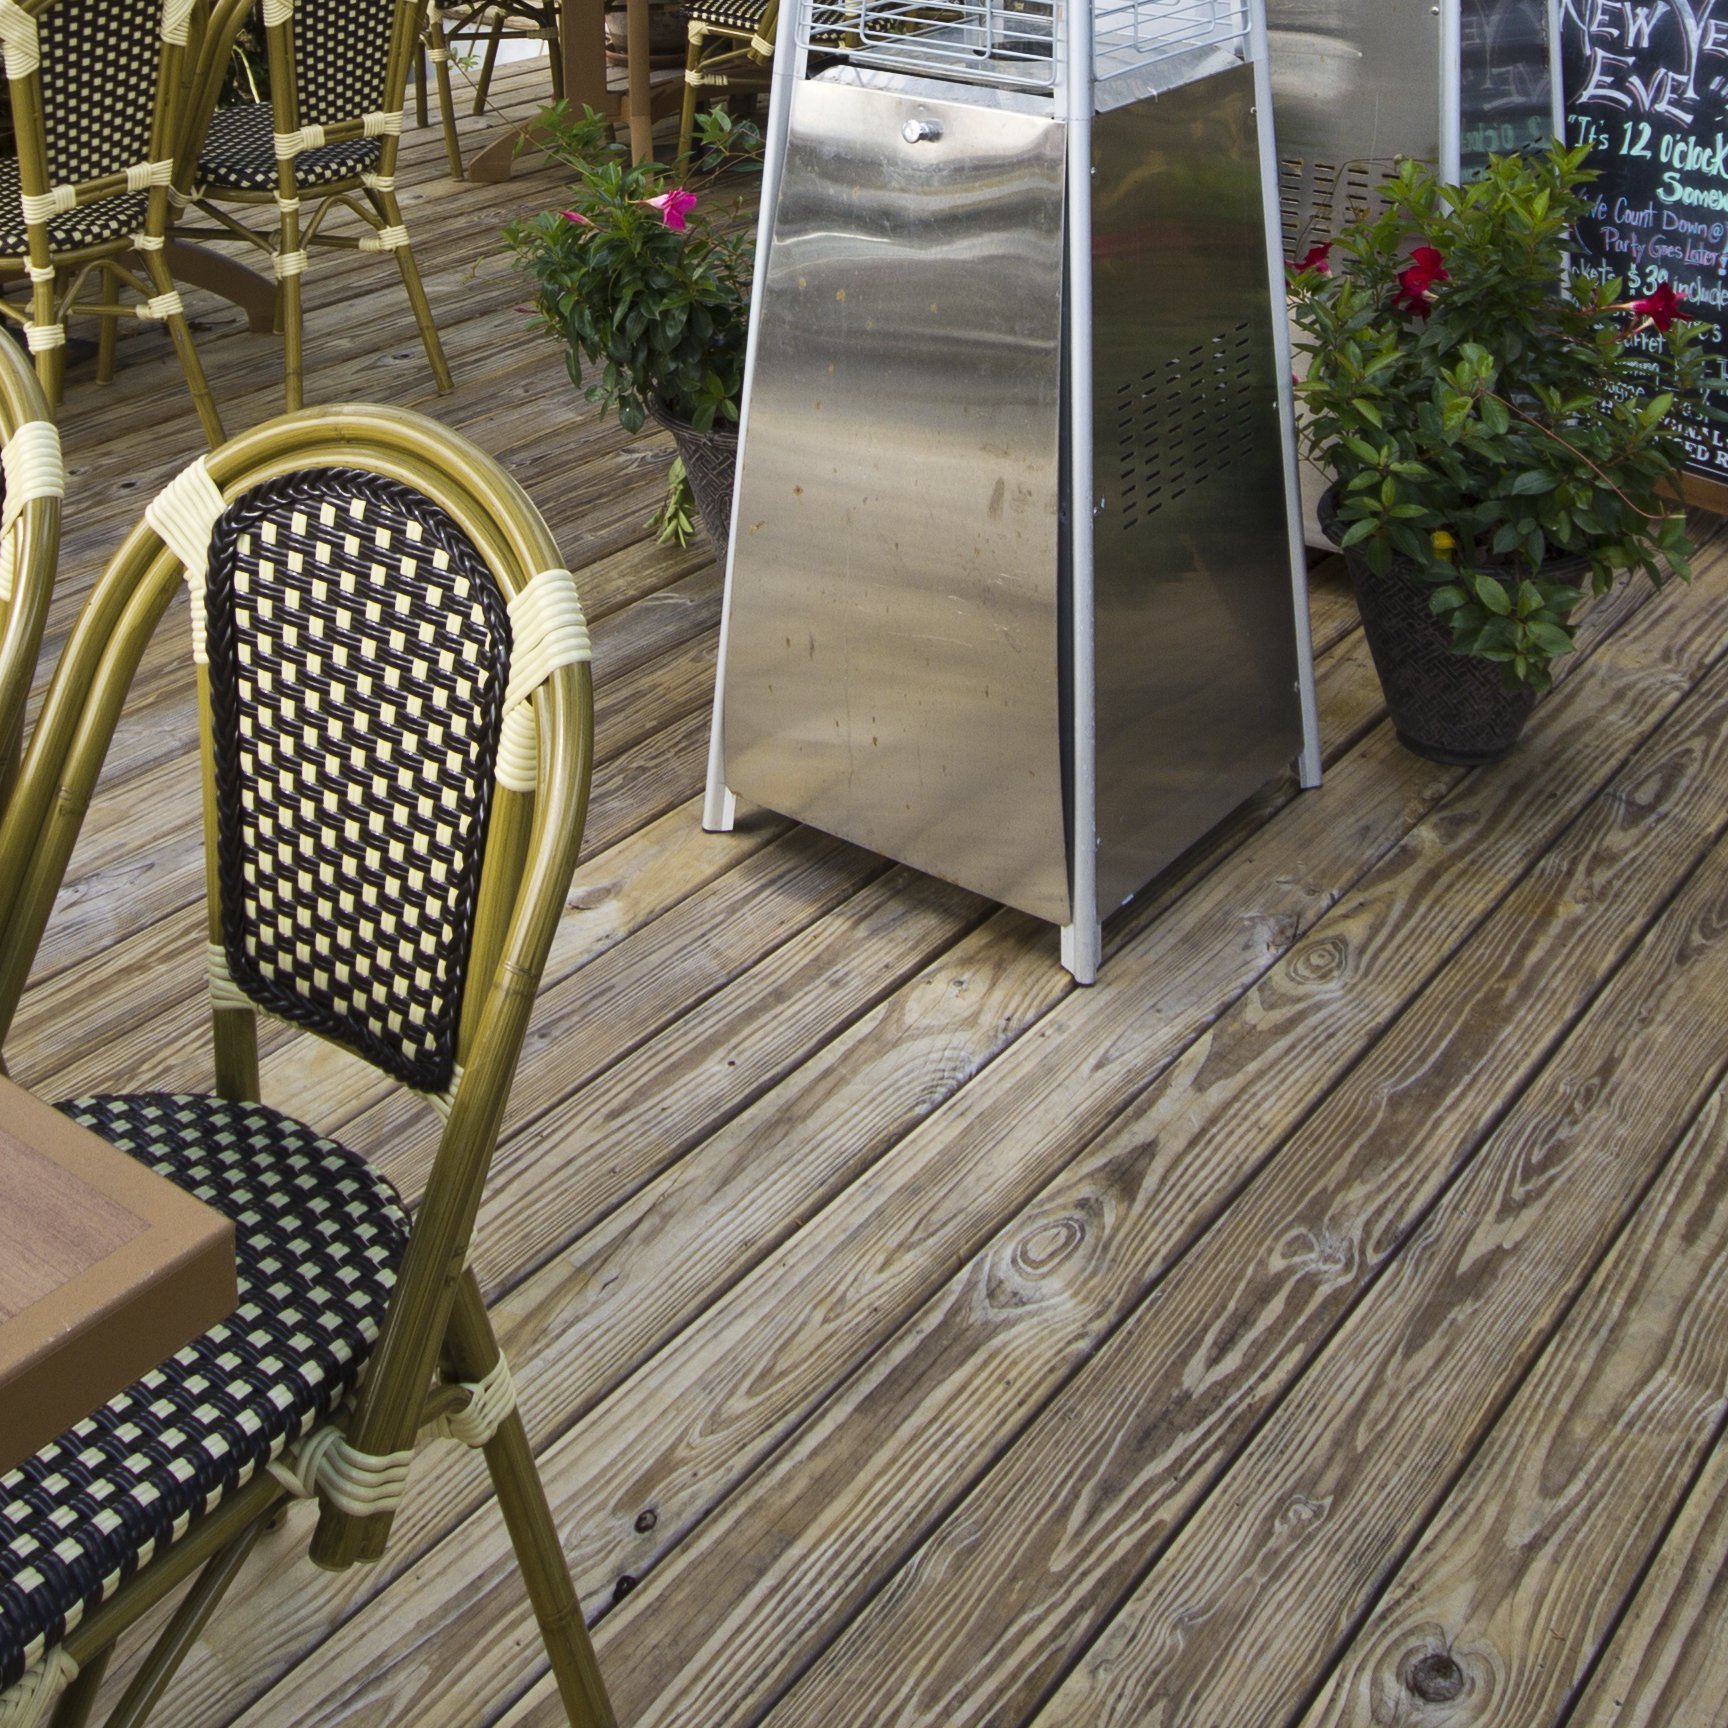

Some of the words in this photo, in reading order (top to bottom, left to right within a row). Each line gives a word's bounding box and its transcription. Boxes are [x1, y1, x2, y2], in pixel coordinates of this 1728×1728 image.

[1575, 47, 1696, 129] EVE
[1618, 120, 1653, 160] 12
[1614, 197, 1659, 229] Count
[1662, 209, 1708, 239] Down
[1600, 226, 1647, 265] Party
[1648, 233, 1684, 265] Goes
